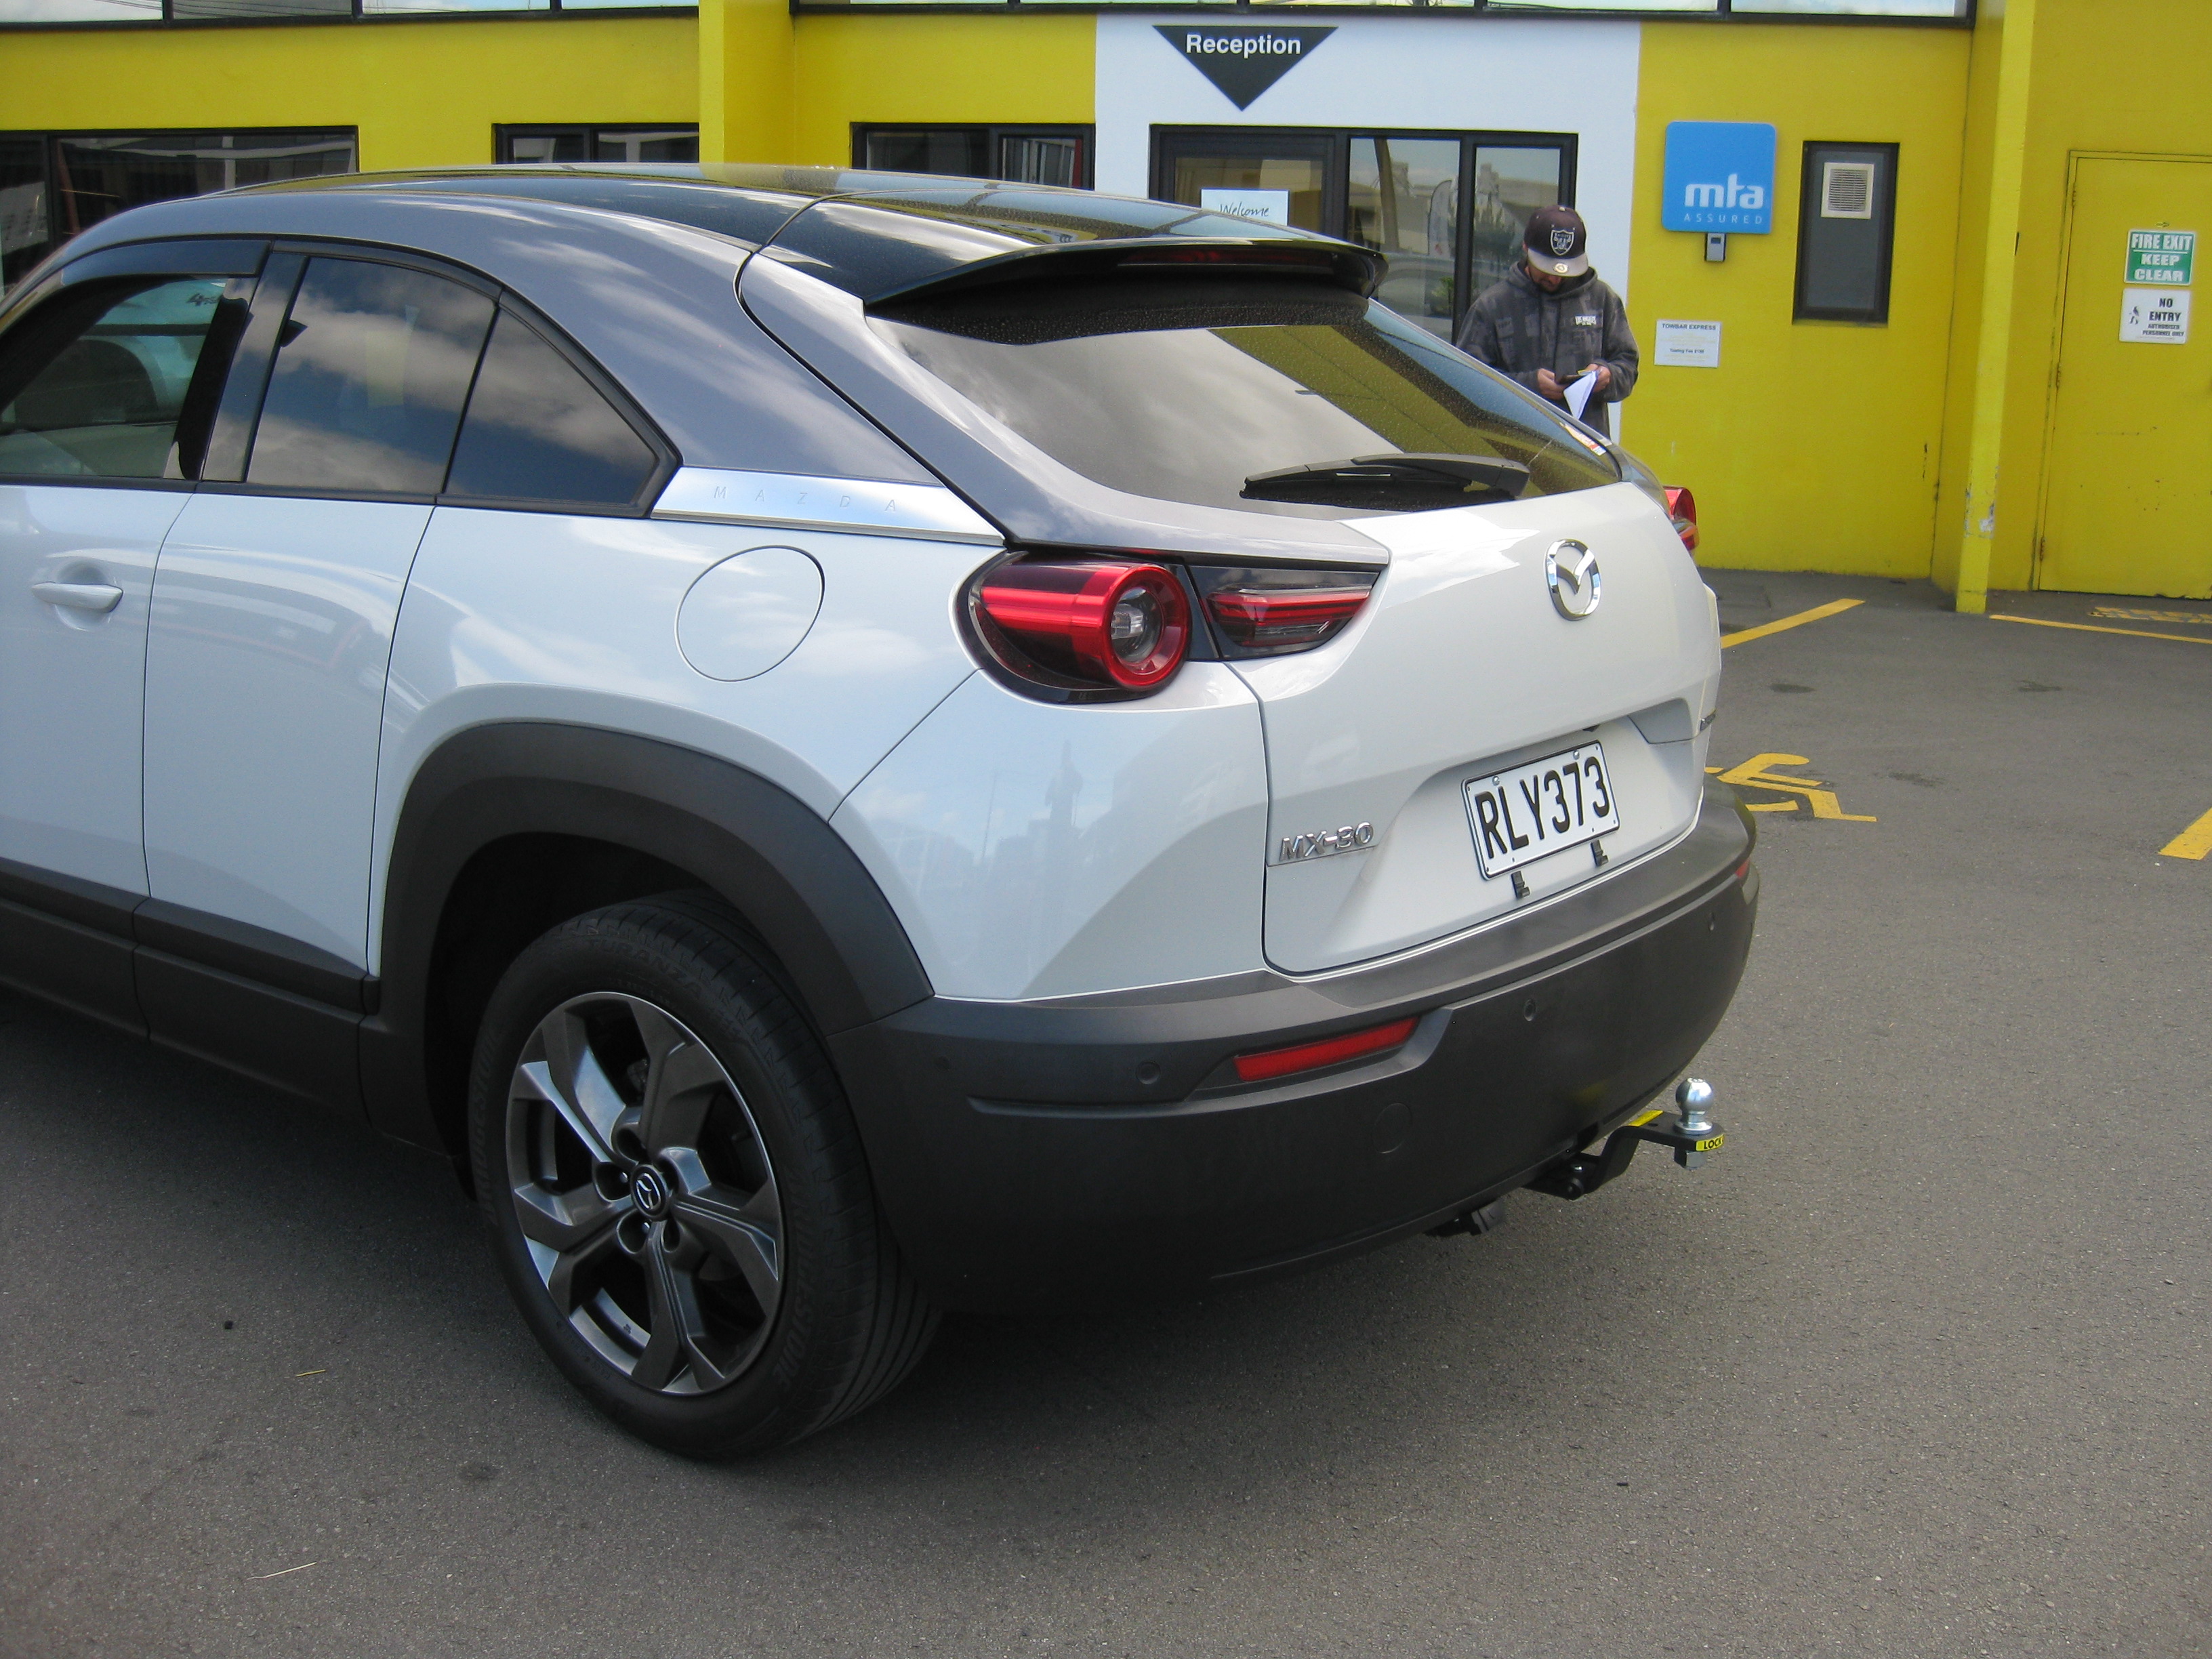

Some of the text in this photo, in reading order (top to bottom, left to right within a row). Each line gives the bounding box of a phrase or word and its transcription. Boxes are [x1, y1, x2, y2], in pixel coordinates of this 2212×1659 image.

[1187, 34, 1301, 59] Reception
[1684, 173, 1764, 209] mta
[1220, 201, 1269, 217] Welcome
[1684, 213, 1762, 224] ASSURED
[2131, 233, 2192, 251] FIRE EXIT
[2141, 253, 2180, 266] KEEP
[2134, 268, 2184, 282] CLEAR
[2158, 298, 2173, 308] NO
[2149, 311, 2182, 322] ENTRY
[714, 486, 897, 512] MAZDA
[1474, 756, 1610, 859] RLY373
[1279, 821, 1374, 861] MX-30
[1703, 1139, 1721, 1150] LOCK
